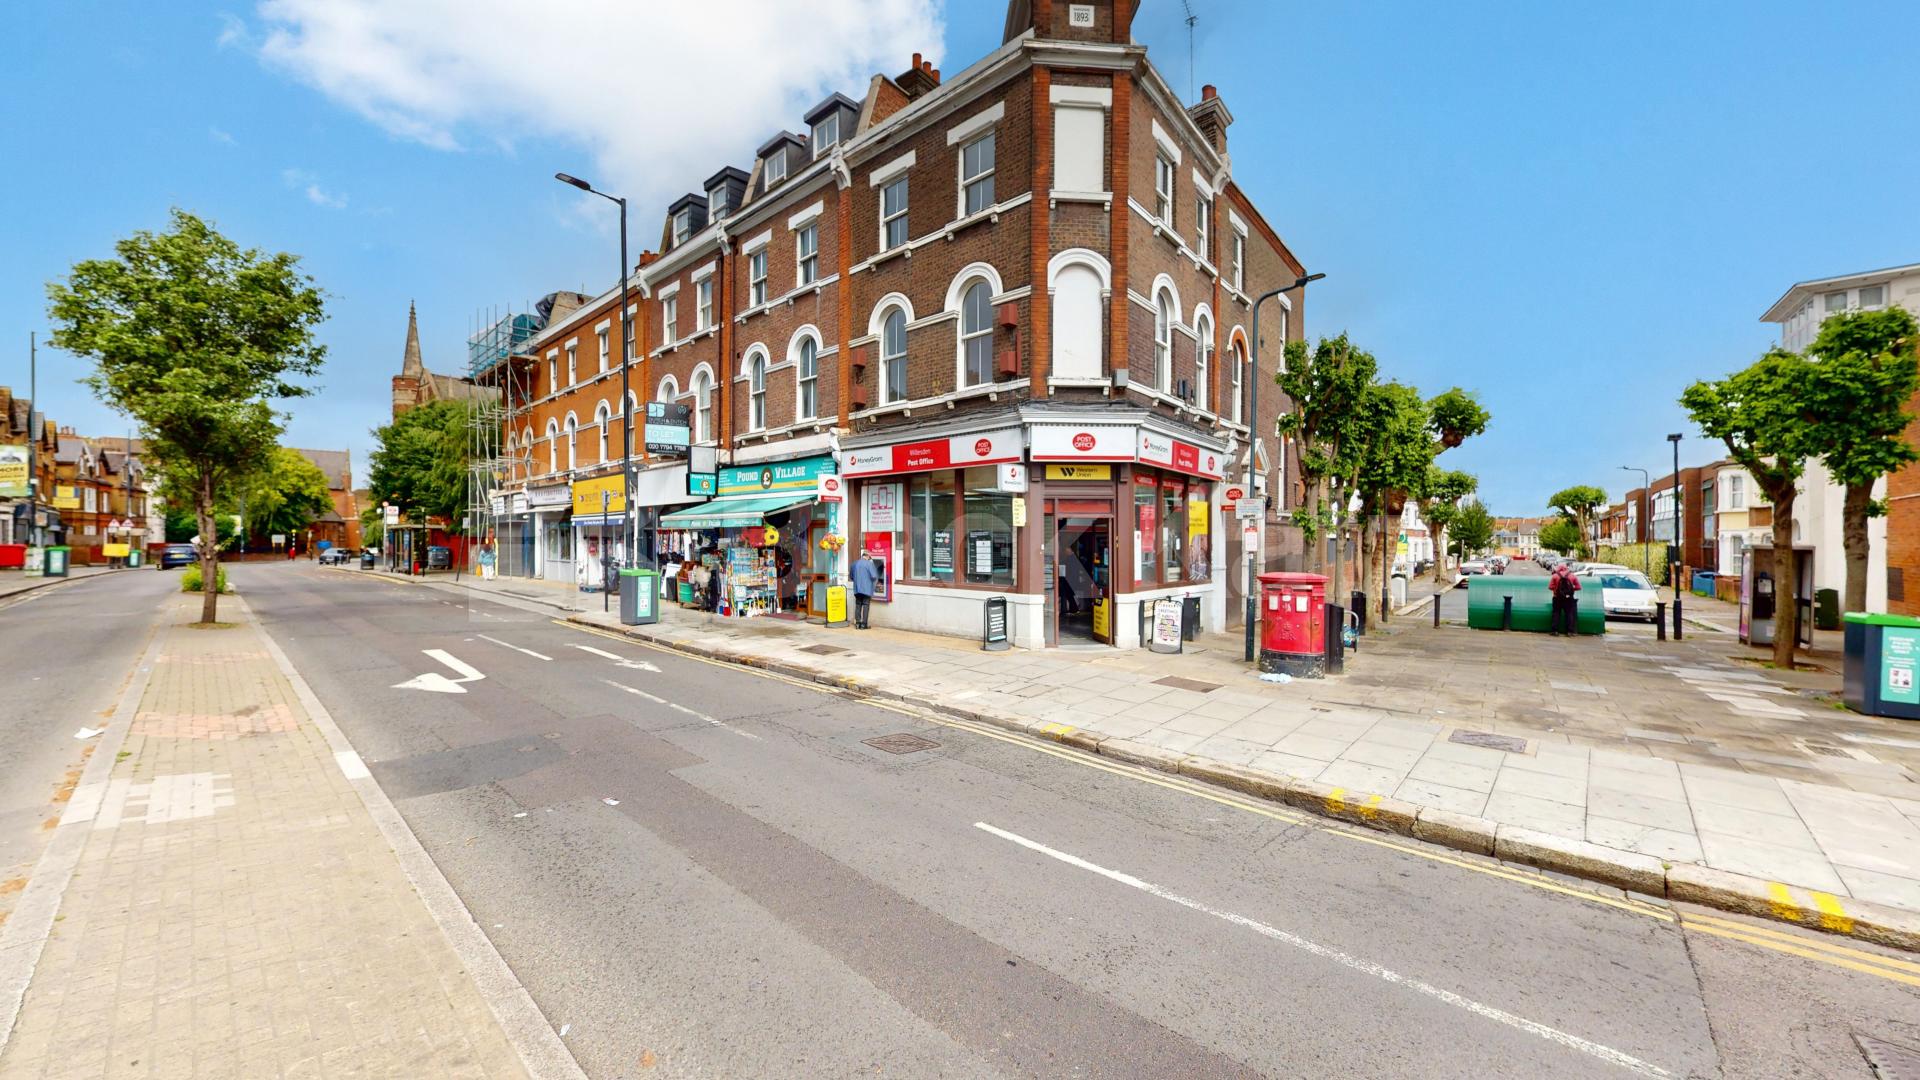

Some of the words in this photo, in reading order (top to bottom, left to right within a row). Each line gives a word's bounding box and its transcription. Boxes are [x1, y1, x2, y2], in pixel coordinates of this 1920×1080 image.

[1073, 12, 1089, 23] 1893
[858, 456, 883, 464] MoneyGram
[919, 457, 934, 465] Office
[736, 471, 758, 482] POUND
[775, 466, 806, 479] VILLAGE
